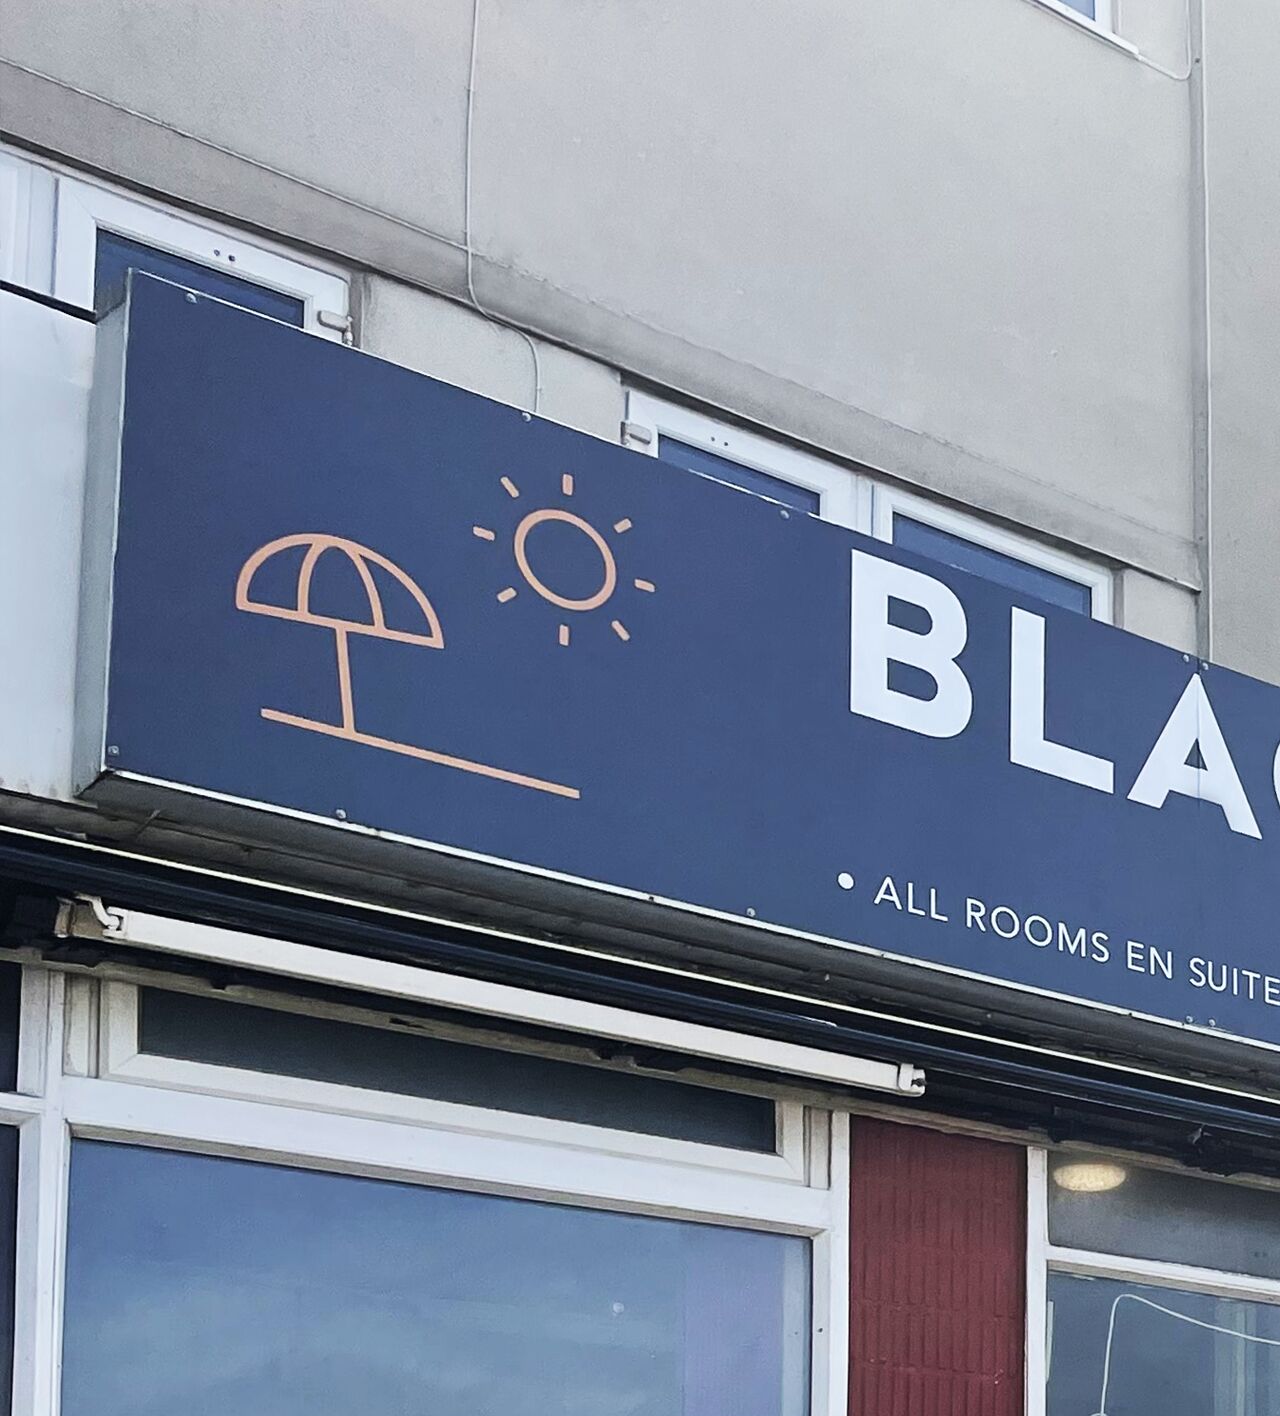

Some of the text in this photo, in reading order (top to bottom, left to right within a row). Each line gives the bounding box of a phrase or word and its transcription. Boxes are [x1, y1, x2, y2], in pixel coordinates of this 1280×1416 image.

[874, 876, 949, 922] ALL
[965, 898, 1110, 963] ROOMS
[1128, 941, 1174, 980] EN
